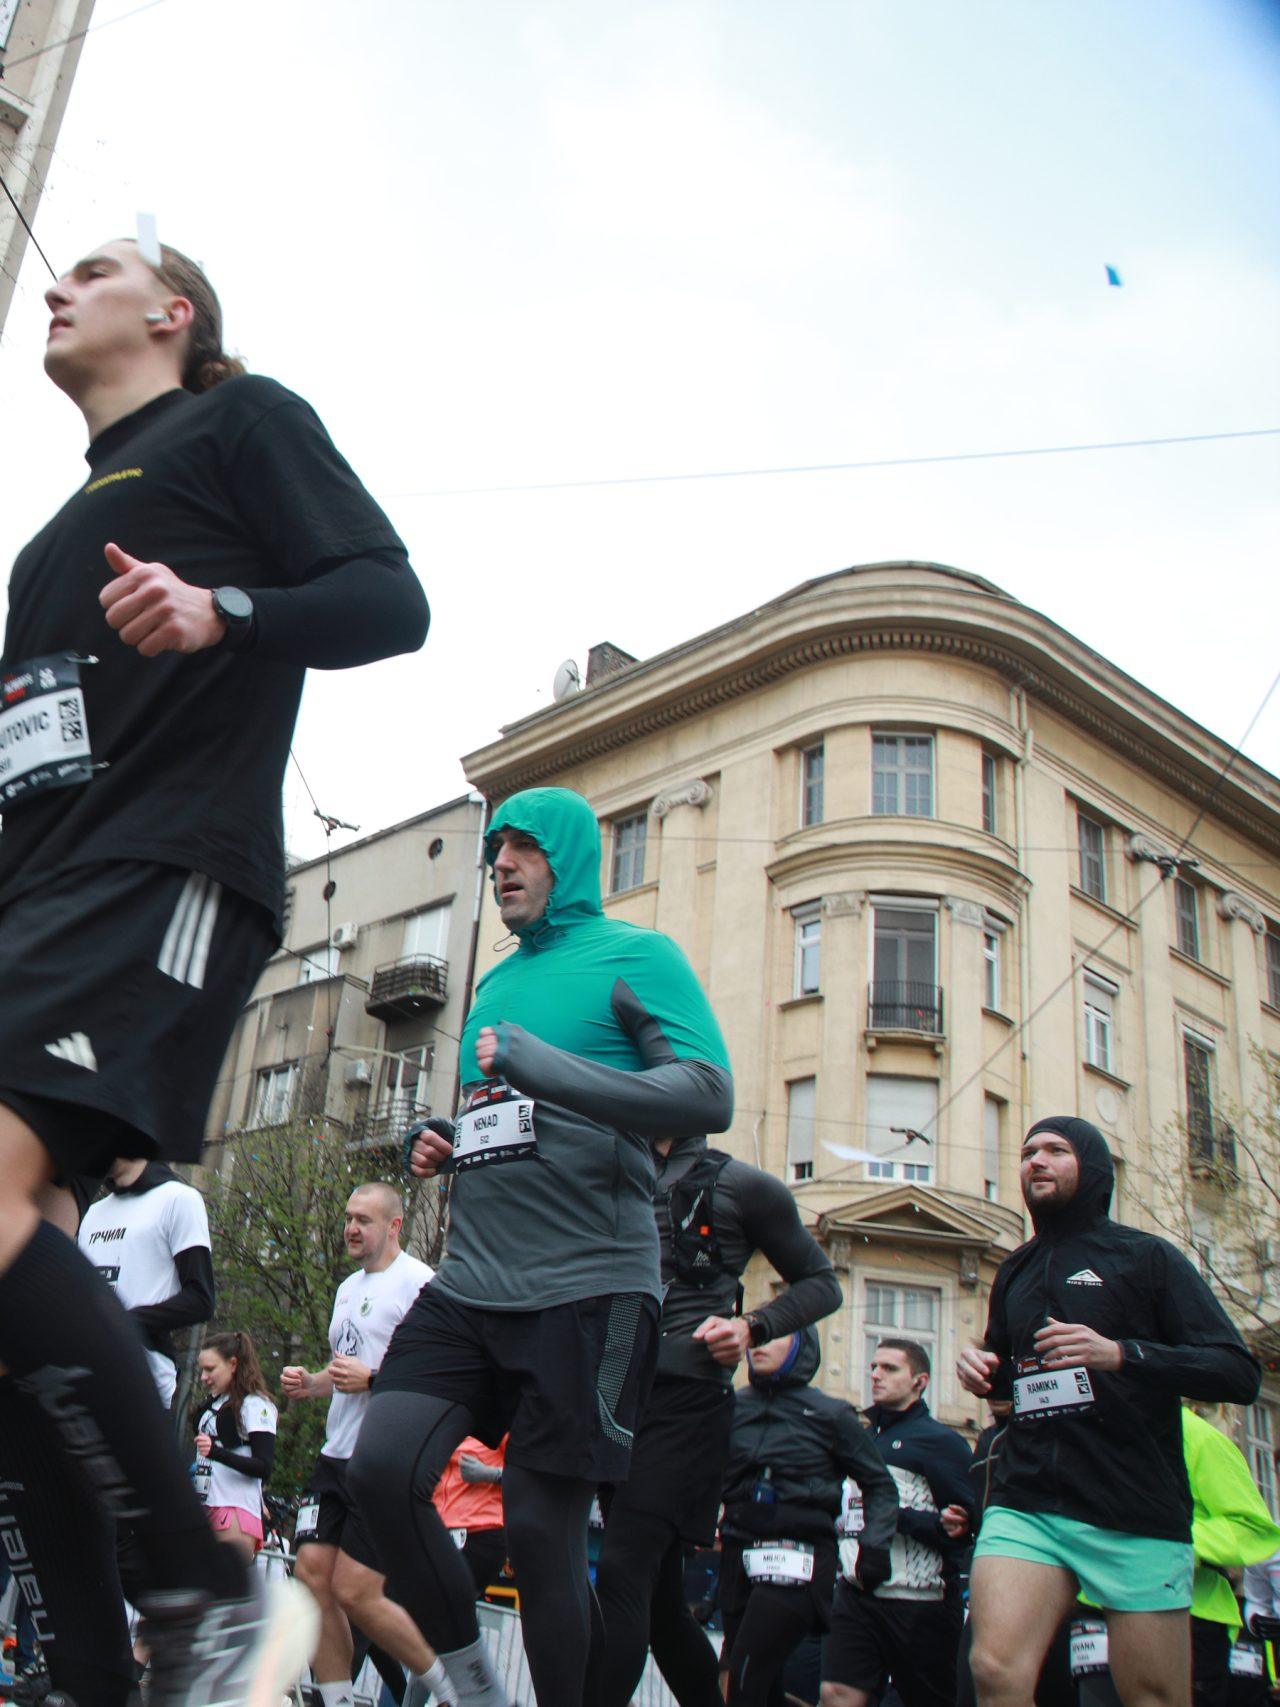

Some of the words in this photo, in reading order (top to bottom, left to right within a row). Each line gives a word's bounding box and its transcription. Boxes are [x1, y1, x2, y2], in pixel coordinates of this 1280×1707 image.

[473, 1113, 498, 1131] NENAD
[89, 1228, 126, 1246] ТРЧИМ
[1026, 1379, 1058, 1394] RAMIKH
